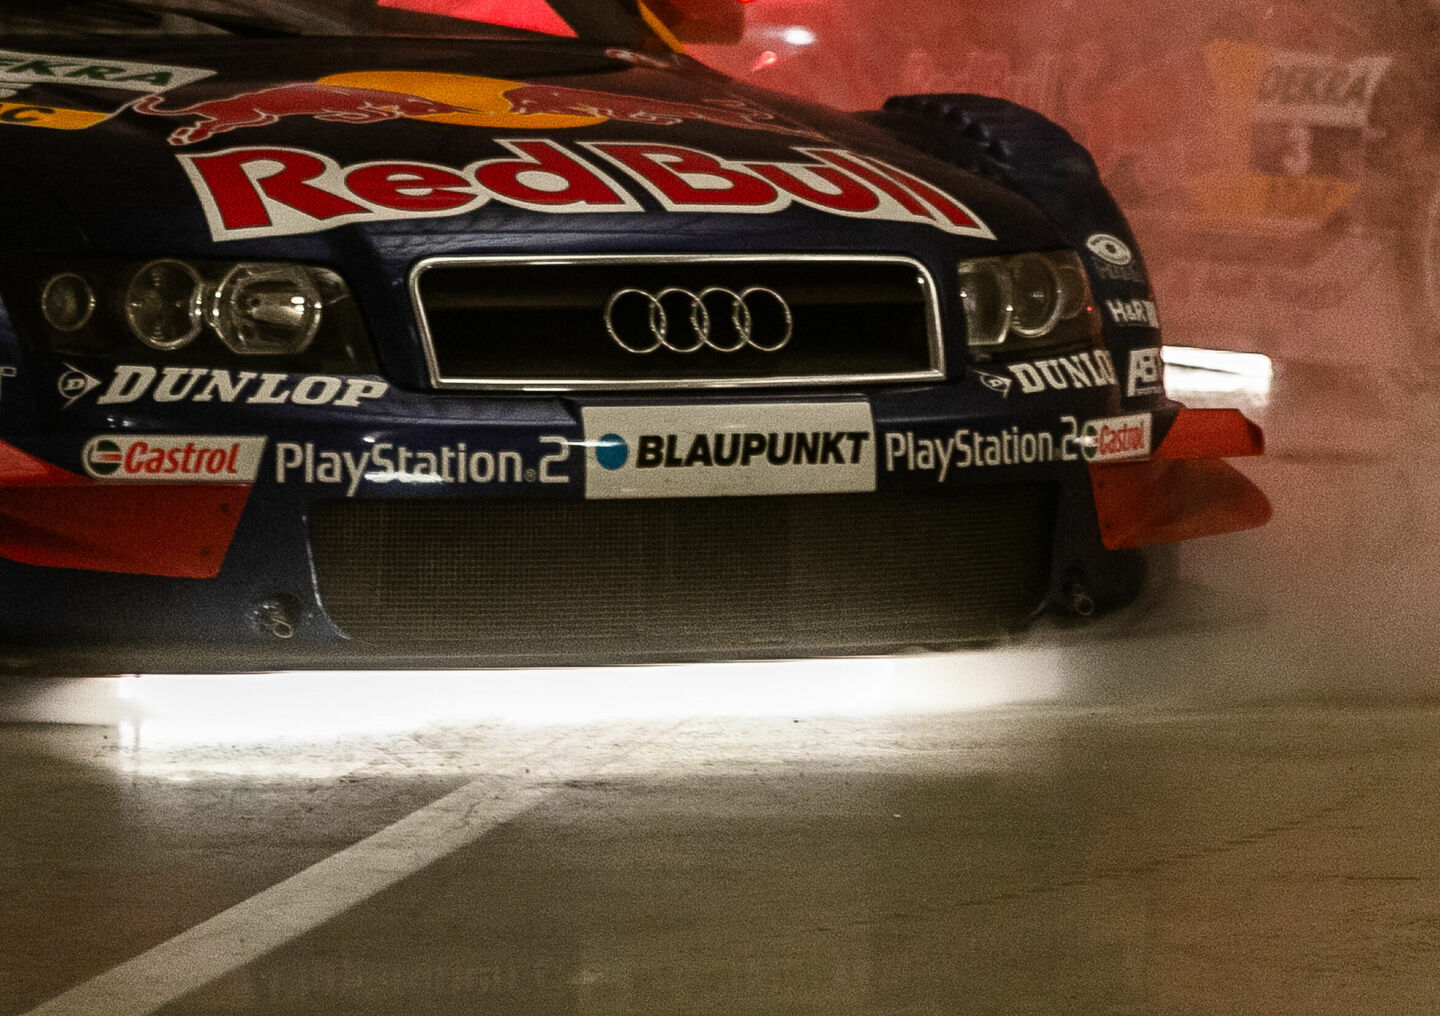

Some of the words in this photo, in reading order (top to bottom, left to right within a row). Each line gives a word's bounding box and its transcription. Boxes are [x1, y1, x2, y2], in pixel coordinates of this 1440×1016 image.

[176, 139, 645, 241] Red
[578, 140, 997, 240] Bull
[97, 365, 390, 406] DUNLOP
[1008, 350, 1118, 394] DUNLO
[121, 441, 240, 474] Castrol
[635, 431, 871, 469] BLAUPUNKT
